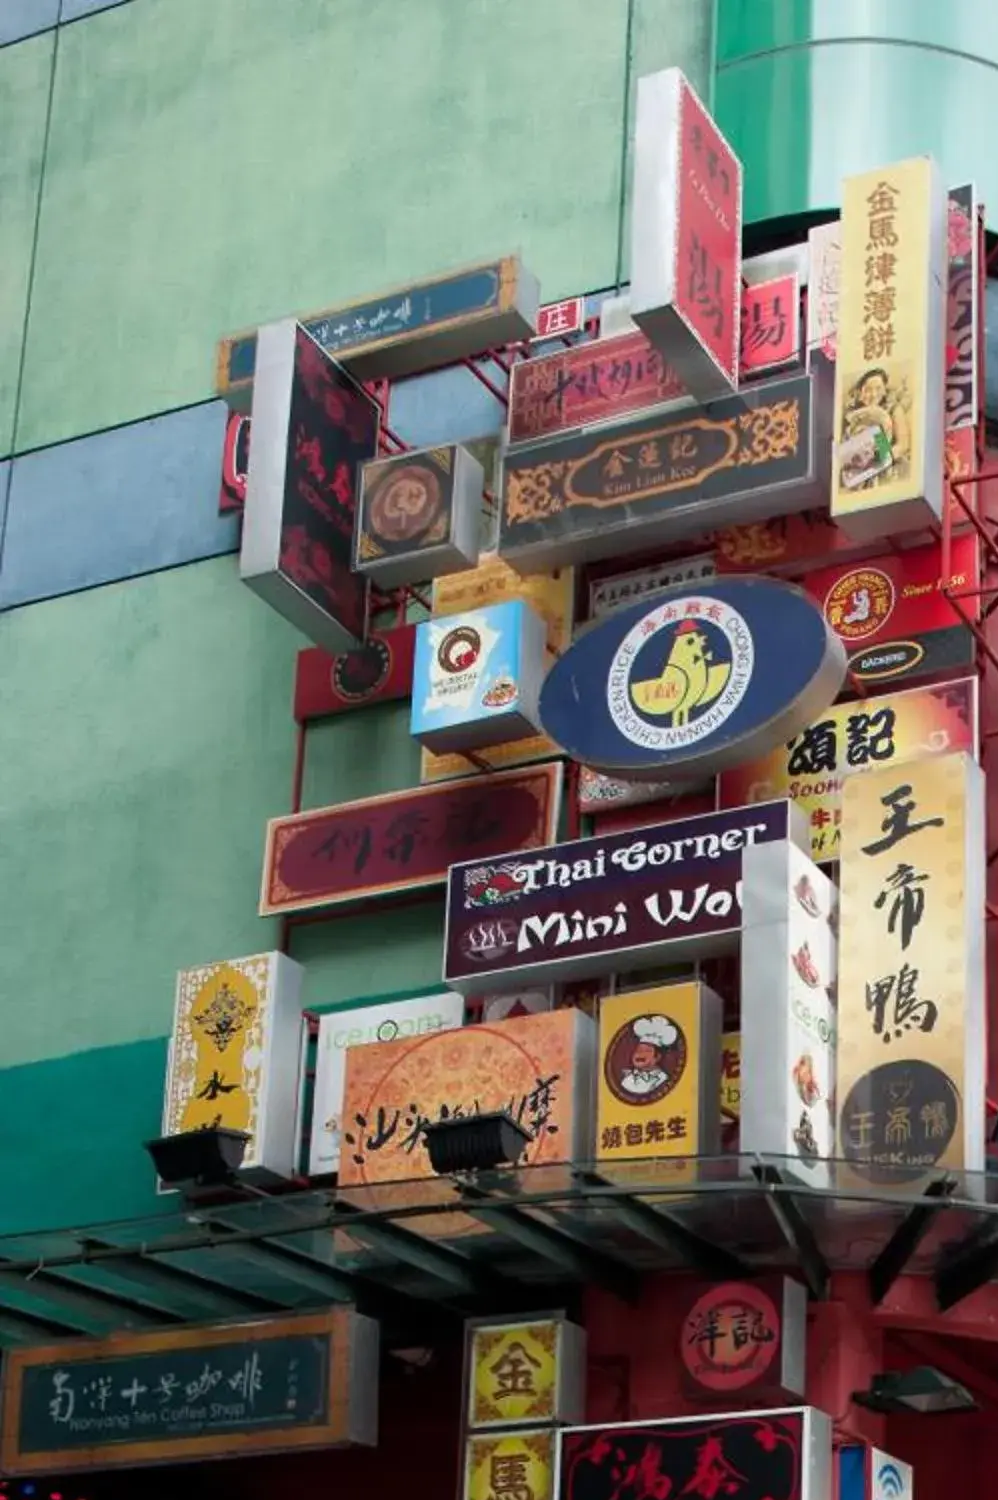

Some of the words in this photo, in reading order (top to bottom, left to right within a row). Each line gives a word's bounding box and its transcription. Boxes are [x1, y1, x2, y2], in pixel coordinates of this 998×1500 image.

[902, 583, 932, 598] Since
[612, 642, 633, 687] RICE
[511, 850, 606, 893] Thai
[612, 824, 767, 871] Corner
[517, 902, 628, 952] Mini
